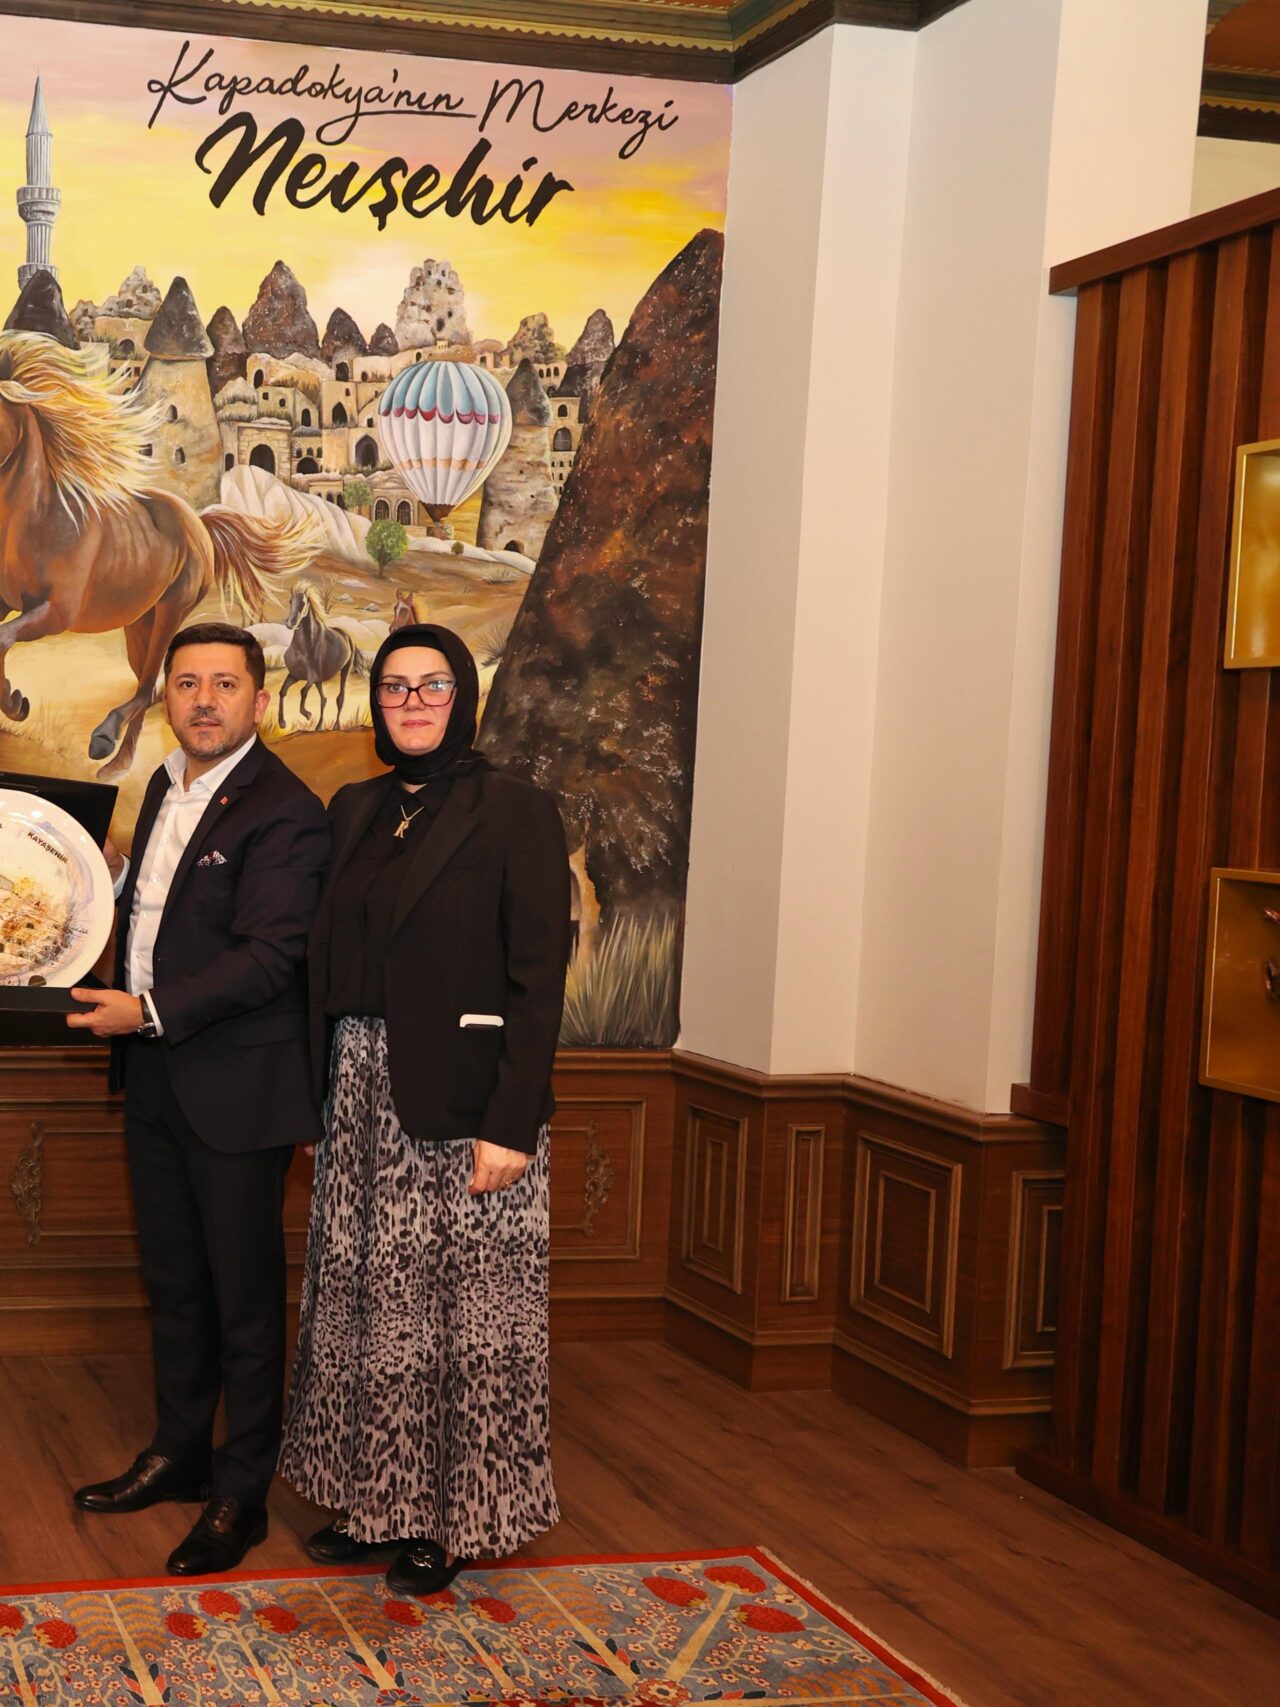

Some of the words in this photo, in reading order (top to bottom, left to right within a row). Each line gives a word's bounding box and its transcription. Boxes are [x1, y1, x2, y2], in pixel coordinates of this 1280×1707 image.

[148, 41, 476, 146] Kapadokya'nın
[479, 79, 678, 159] Merkezi
[195, 112, 574, 231] Nevşehir
[27, 831, 68, 864] KAYAŞEHİR
